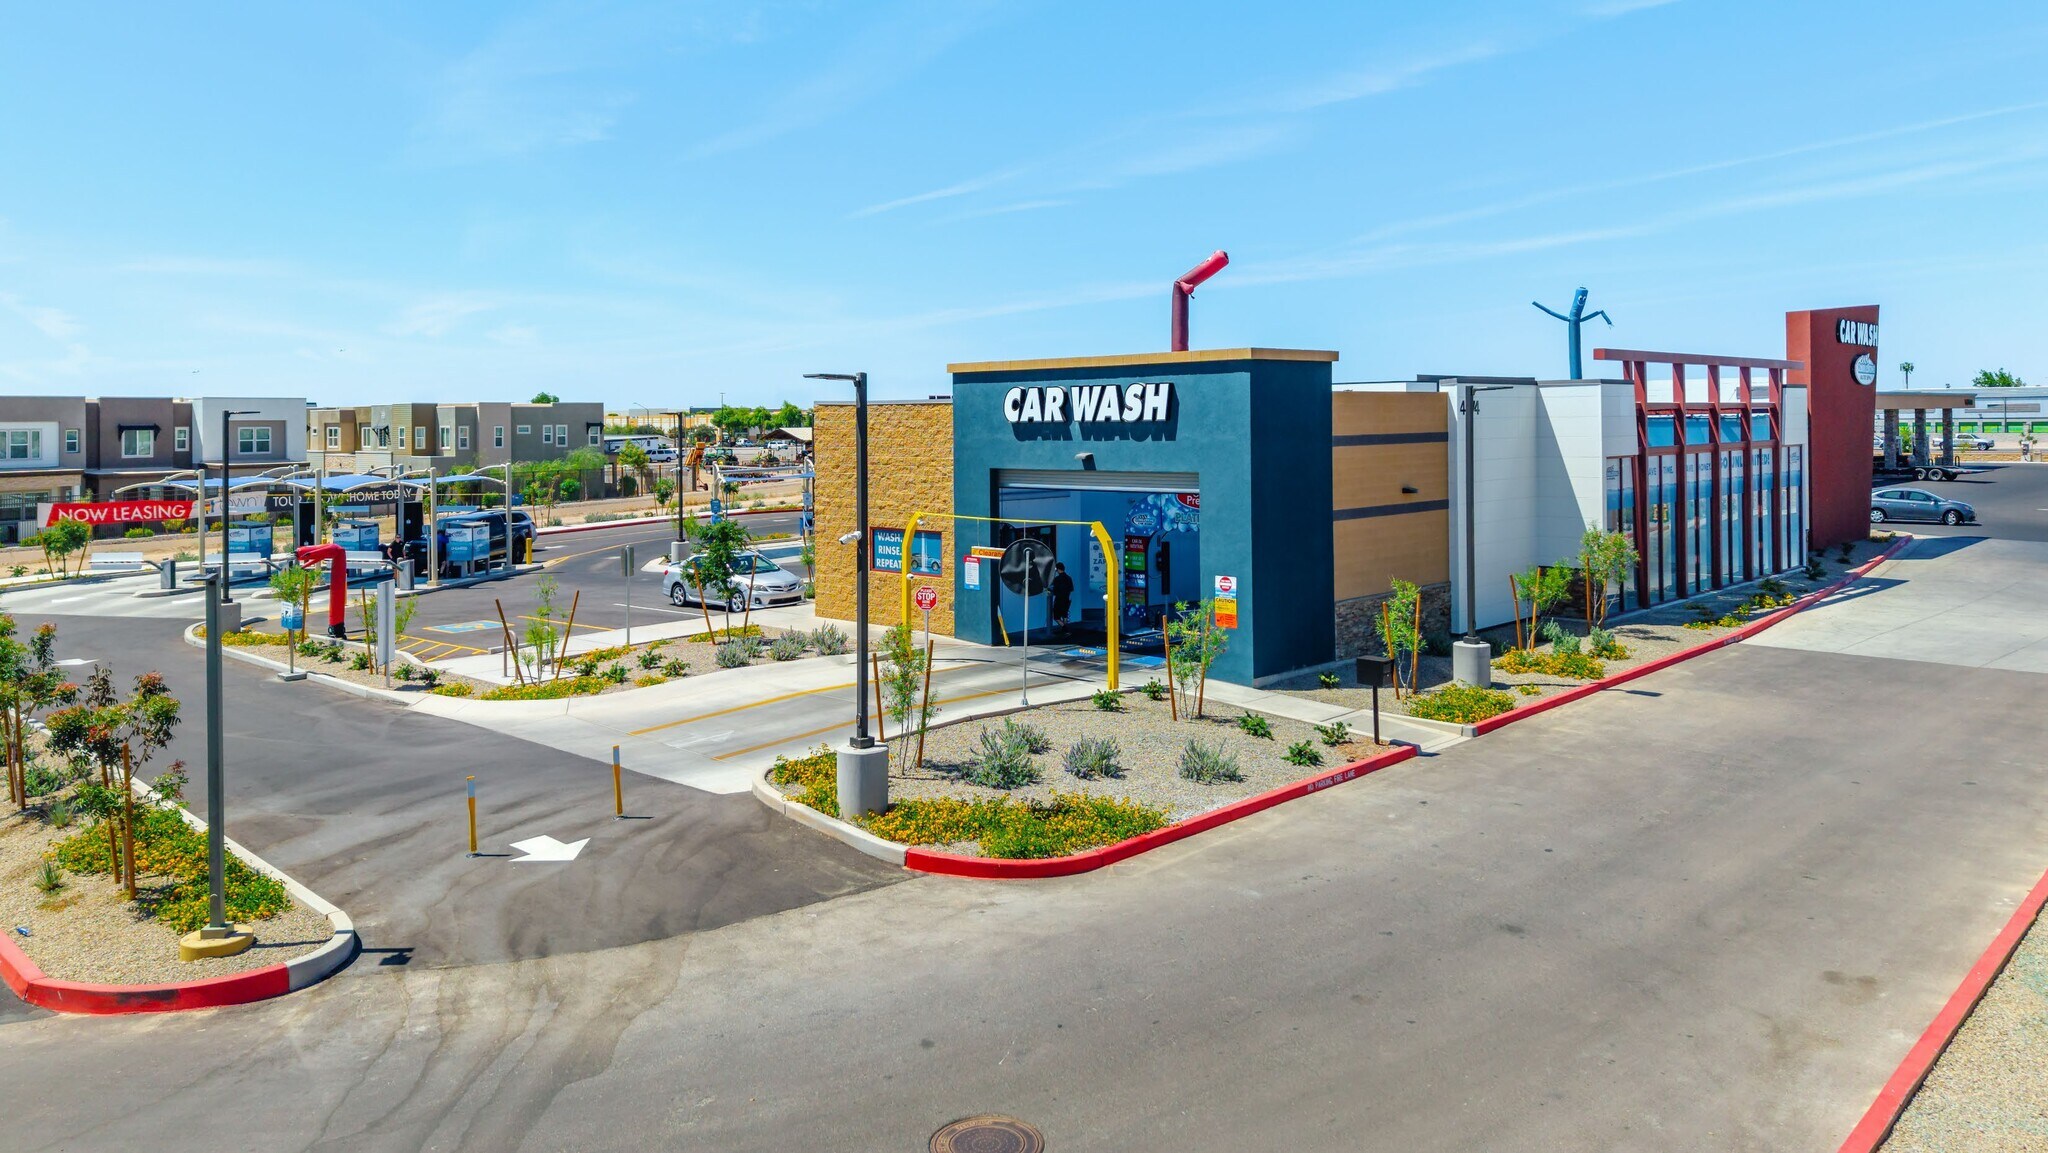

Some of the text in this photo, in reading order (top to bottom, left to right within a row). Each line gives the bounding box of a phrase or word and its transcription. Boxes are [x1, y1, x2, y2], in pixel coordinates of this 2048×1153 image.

[1840, 319, 1879, 347] CAR WASH
[1004, 383, 1170, 422] CAR WASH
[58, 508, 108, 522] NOW
[113, 504, 186, 521] LEASING
[381, 487, 412, 499] TODY
[877, 532, 903, 543] WASH.
[878, 545, 902, 556] RINSE.
[917, 592, 936, 601] STOP
